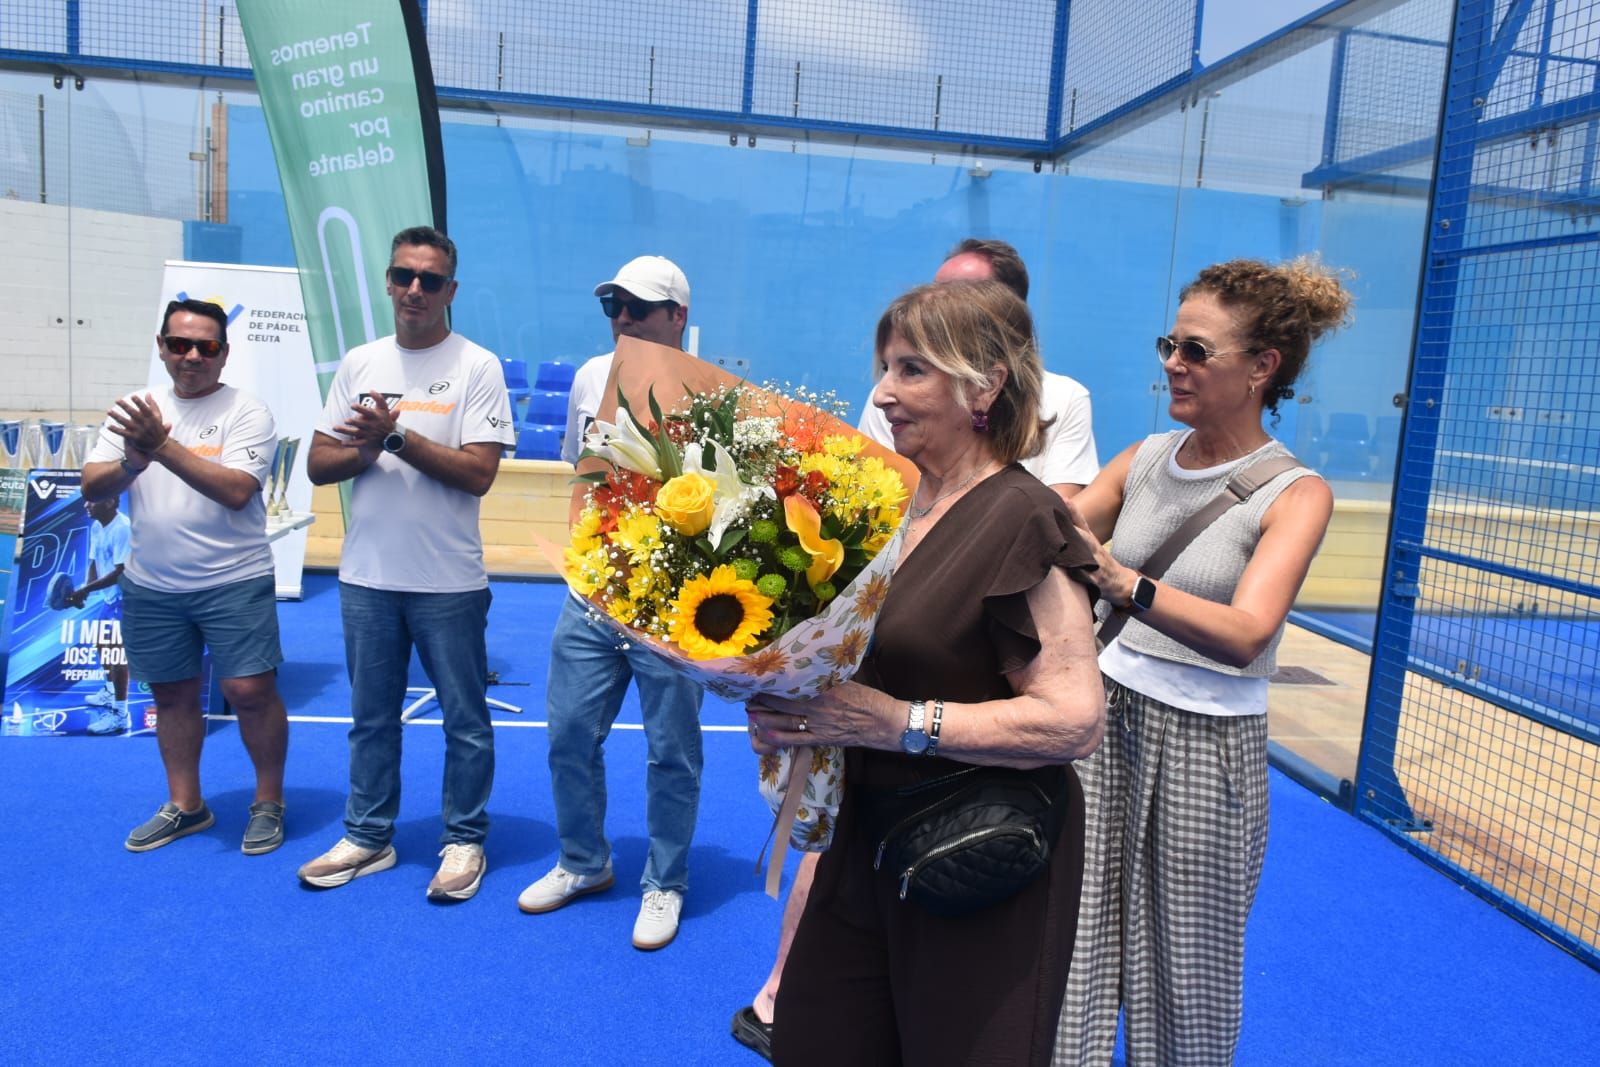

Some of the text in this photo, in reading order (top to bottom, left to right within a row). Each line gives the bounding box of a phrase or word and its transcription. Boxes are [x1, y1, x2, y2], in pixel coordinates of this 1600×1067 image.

[250, 309, 307, 321] FEDERACI
[249, 320, 302, 333] DE PÁDEL
[247, 333, 281, 343] CEUTA
[60, 619, 75, 645] II
[62, 643, 98, 665] JOSÉ
